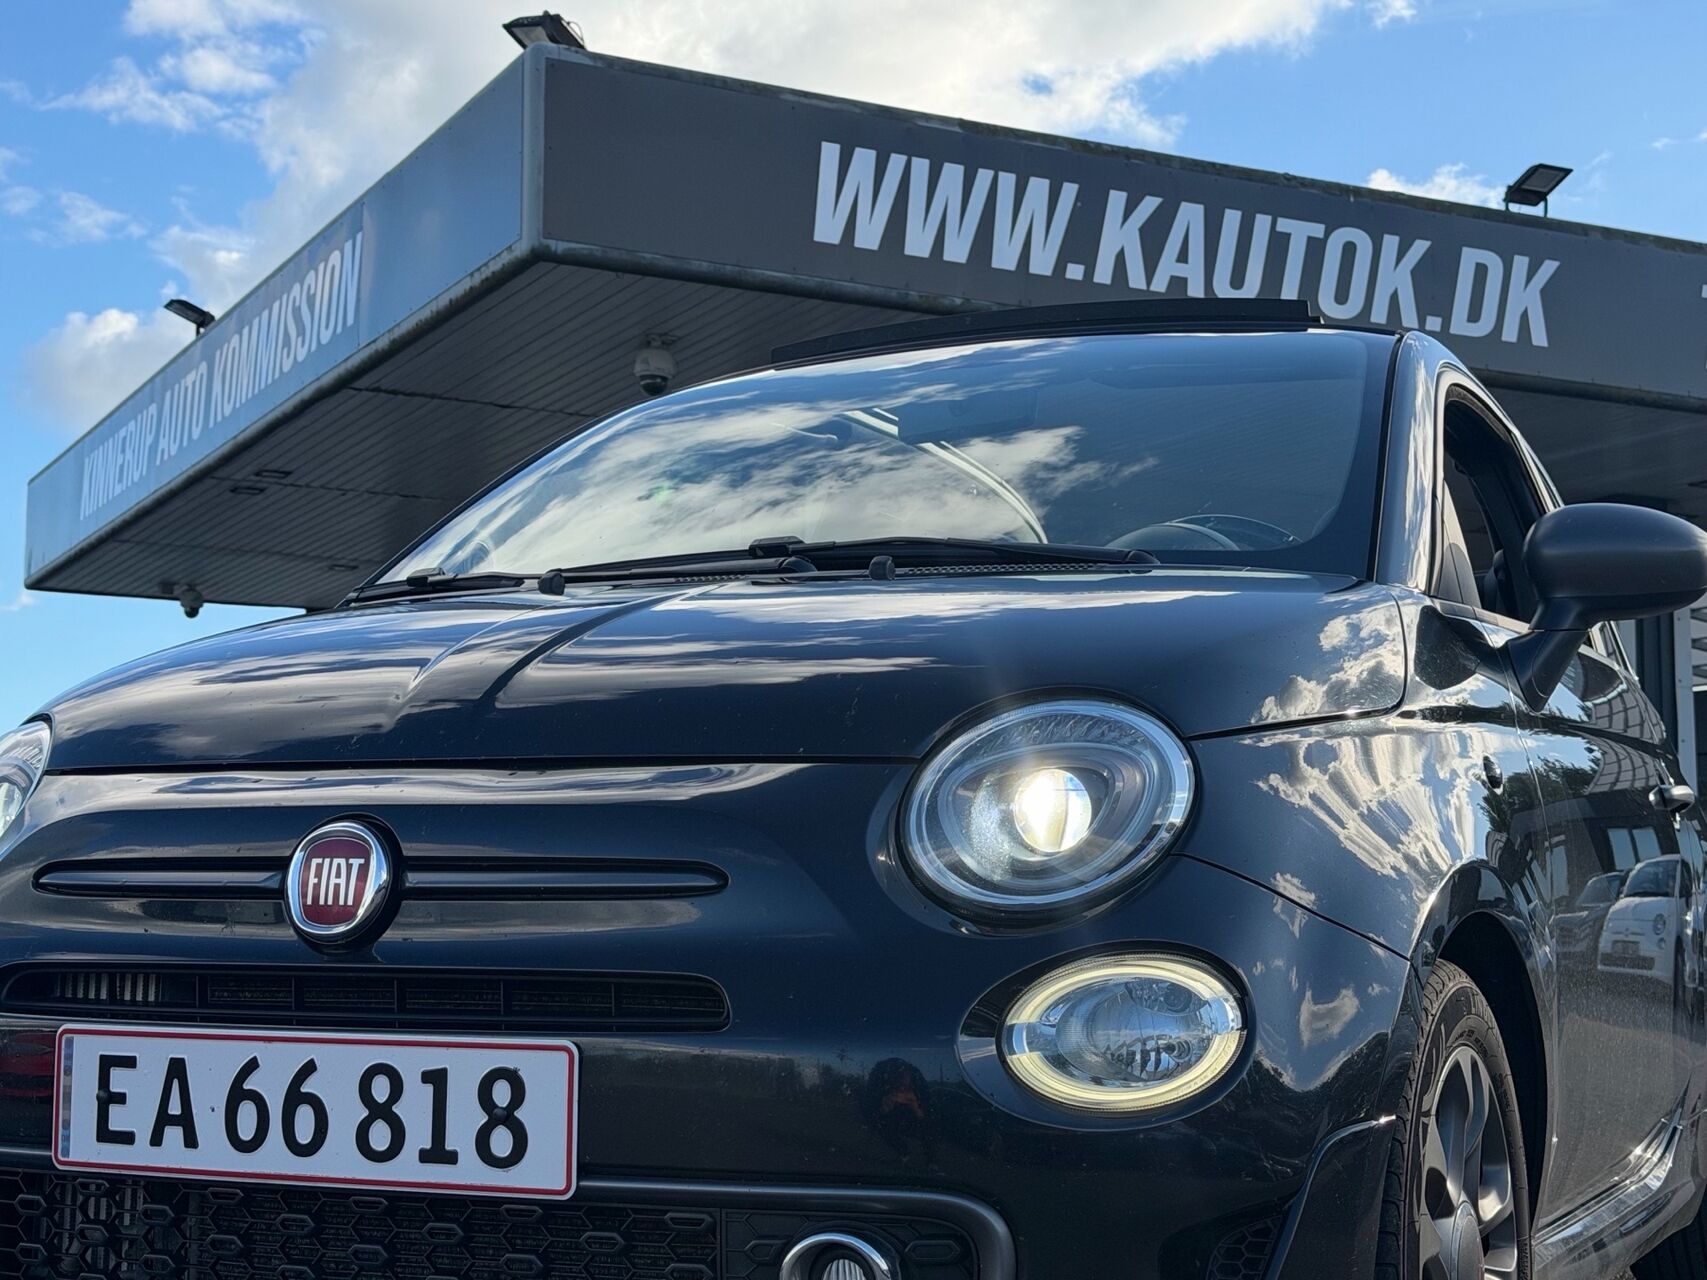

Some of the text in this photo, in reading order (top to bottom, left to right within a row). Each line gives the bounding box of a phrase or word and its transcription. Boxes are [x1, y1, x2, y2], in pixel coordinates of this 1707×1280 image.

[813, 141, 1561, 348] WWW.KAUTOK.DK
[79, 230, 363, 521] KINNERUP AUTO KOMMISSION
[306, 858, 366, 906] FIAT
[96, 1053, 529, 1170] EA 66 818
